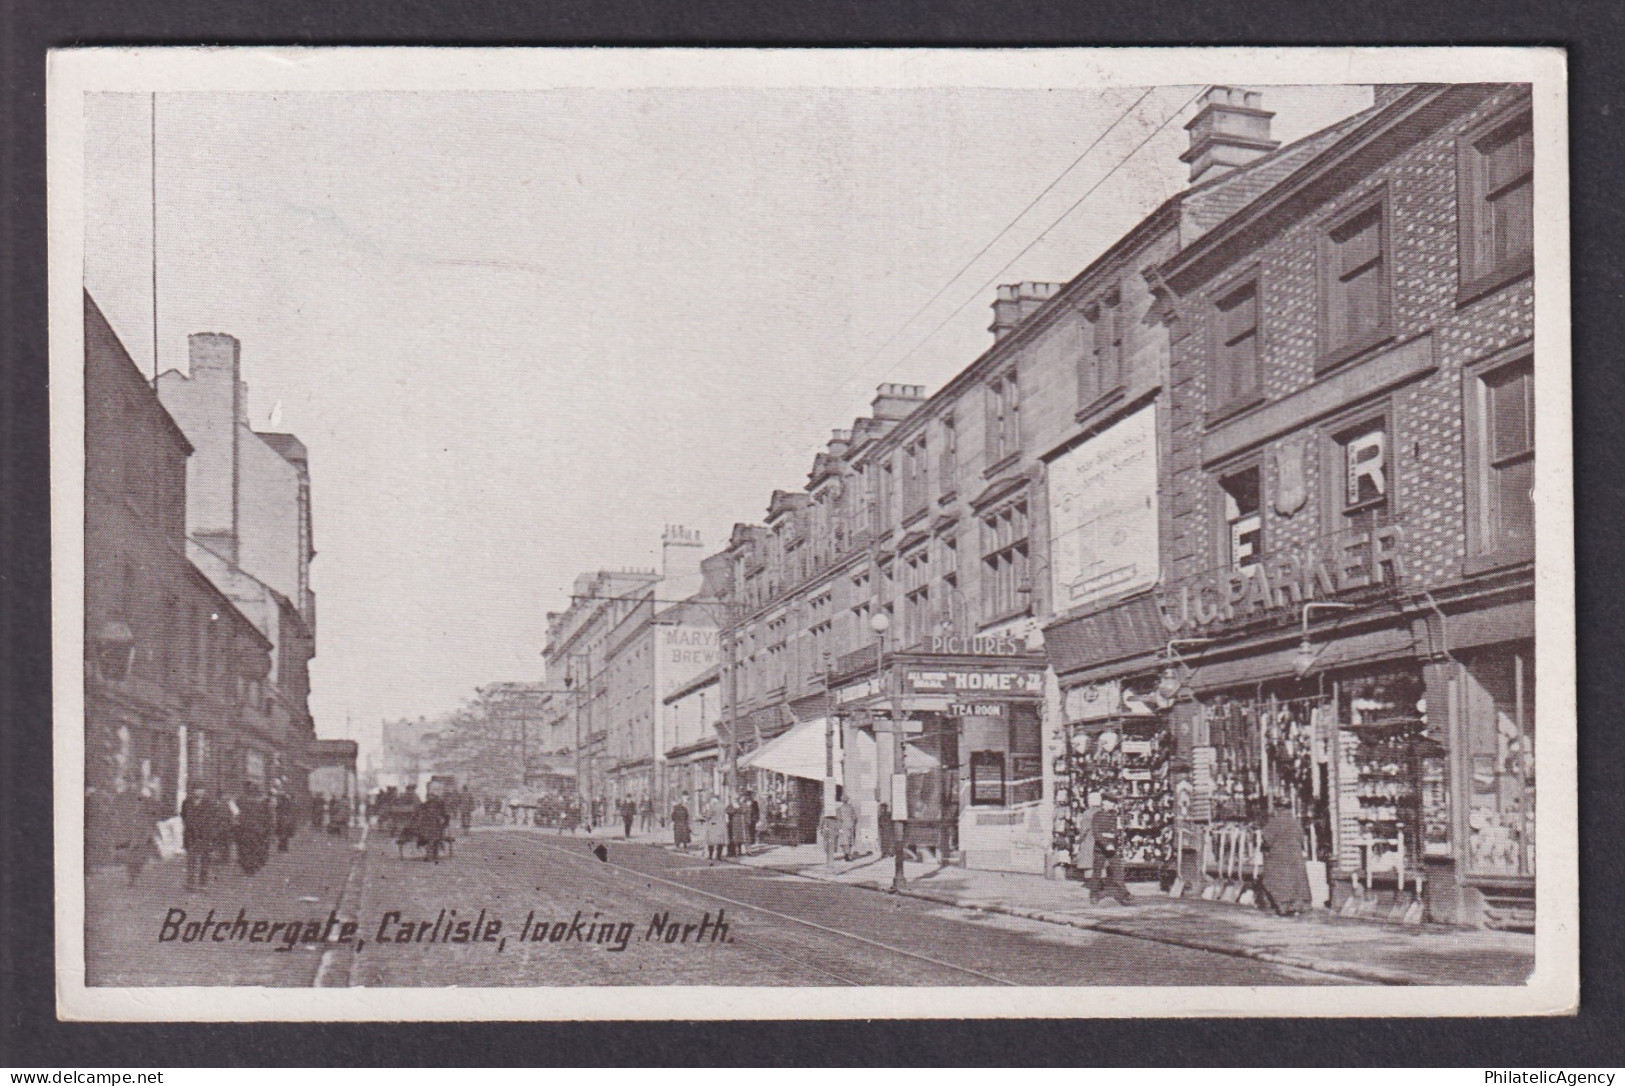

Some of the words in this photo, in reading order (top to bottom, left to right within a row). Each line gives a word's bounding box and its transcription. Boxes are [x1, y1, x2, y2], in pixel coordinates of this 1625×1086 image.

[931, 636, 1018, 656] PICTURES
[671, 648, 720, 664] BREW
[951, 704, 973, 716] TEA
[975, 704, 1001, 716] ROOM
